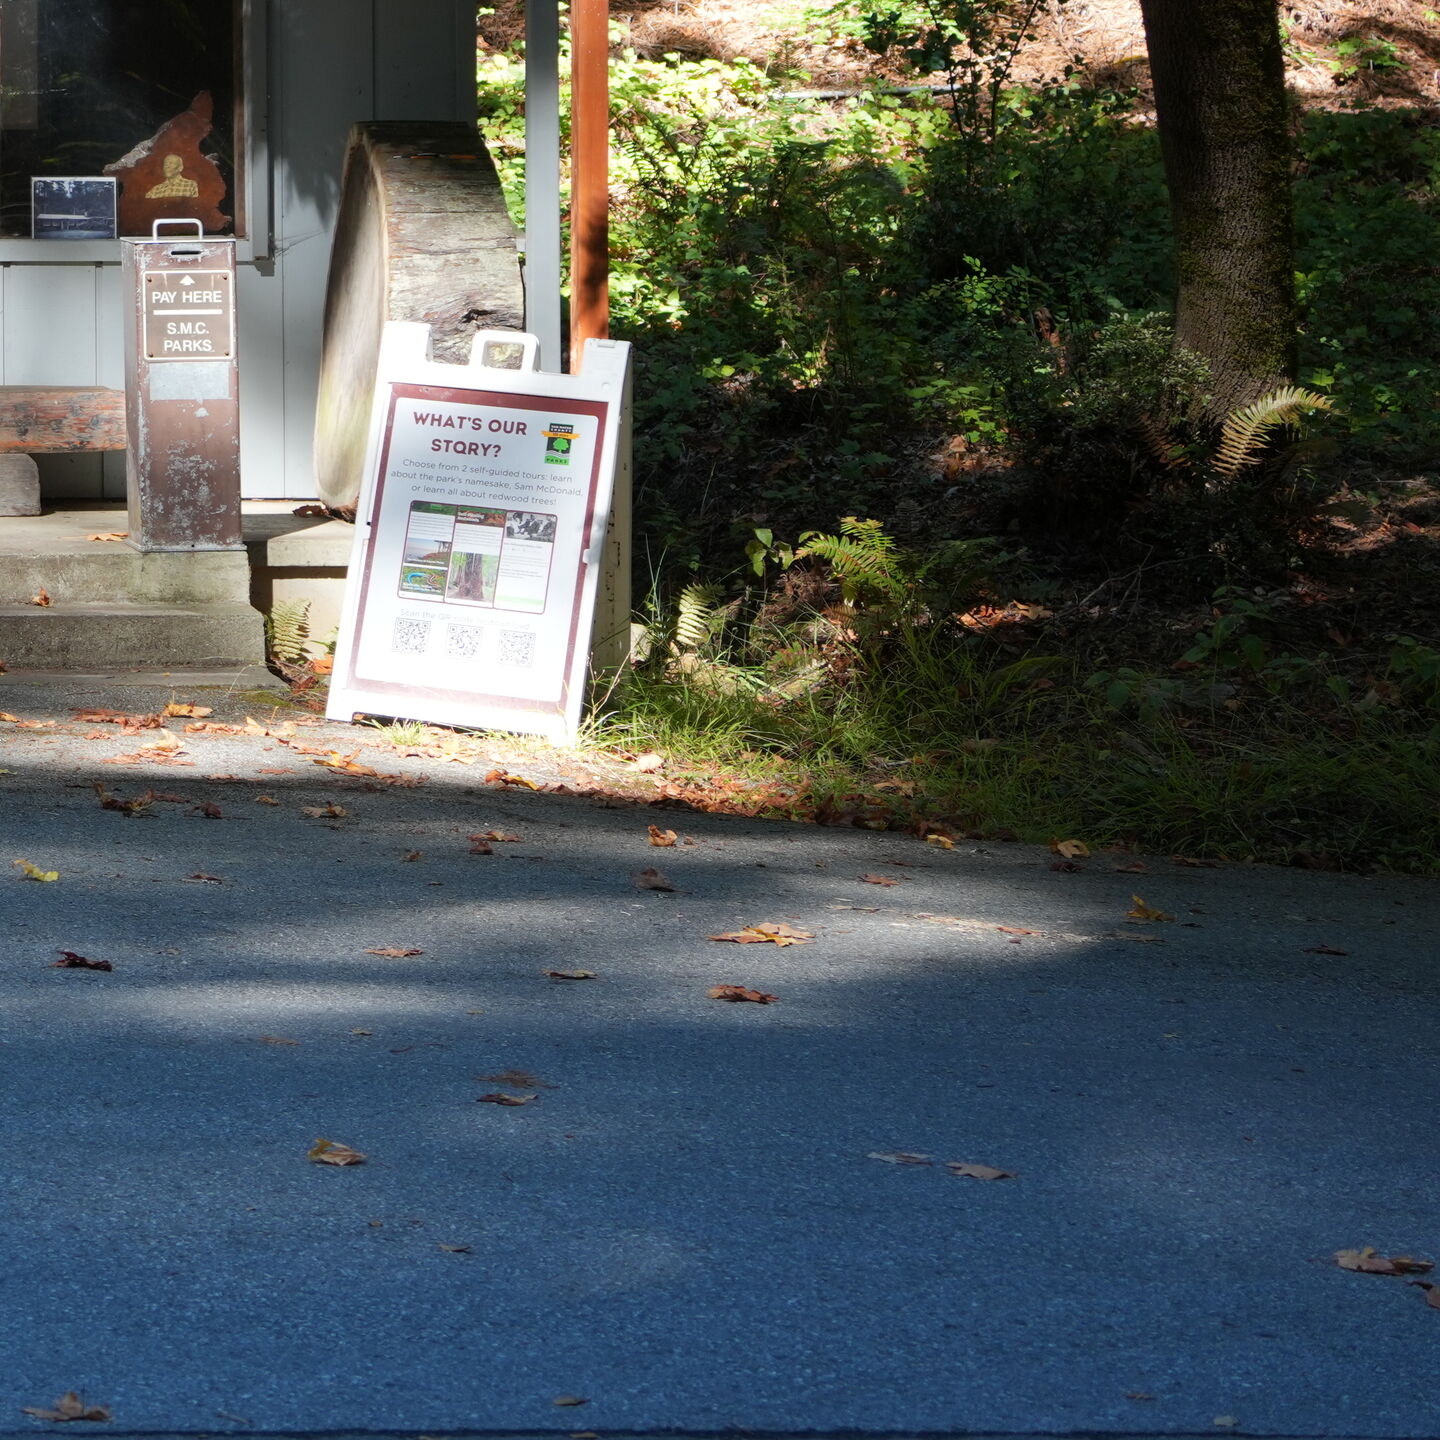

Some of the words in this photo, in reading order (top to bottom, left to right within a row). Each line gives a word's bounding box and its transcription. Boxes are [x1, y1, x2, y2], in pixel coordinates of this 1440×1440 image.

[152, 291, 177, 304] PAY
[182, 290, 223, 304] HERE
[167, 321, 210, 335] S.M.C.
[164, 339, 213, 352] PARKS
[413, 412, 482, 431] WHAT'S
[488, 419, 527, 436] OUR
[402, 459, 436, 470] Choose
[438, 462, 459, 472] from
[461, 464, 467, 472] 2
[470, 465, 520, 479] self-guided
[522, 471, 548, 481] tours:
[550, 474, 572, 483] learn
[391, 470, 417, 480] about
[420, 472, 434, 481] the
[436, 474, 462, 485] park's
[465, 477, 512, 490] namesake,
[514, 482, 534, 491] Sam
[423, 485, 446, 495] learn
[447, 487, 458, 496] all
[460, 488, 485, 499] about
[489, 491, 529, 503] redwood
